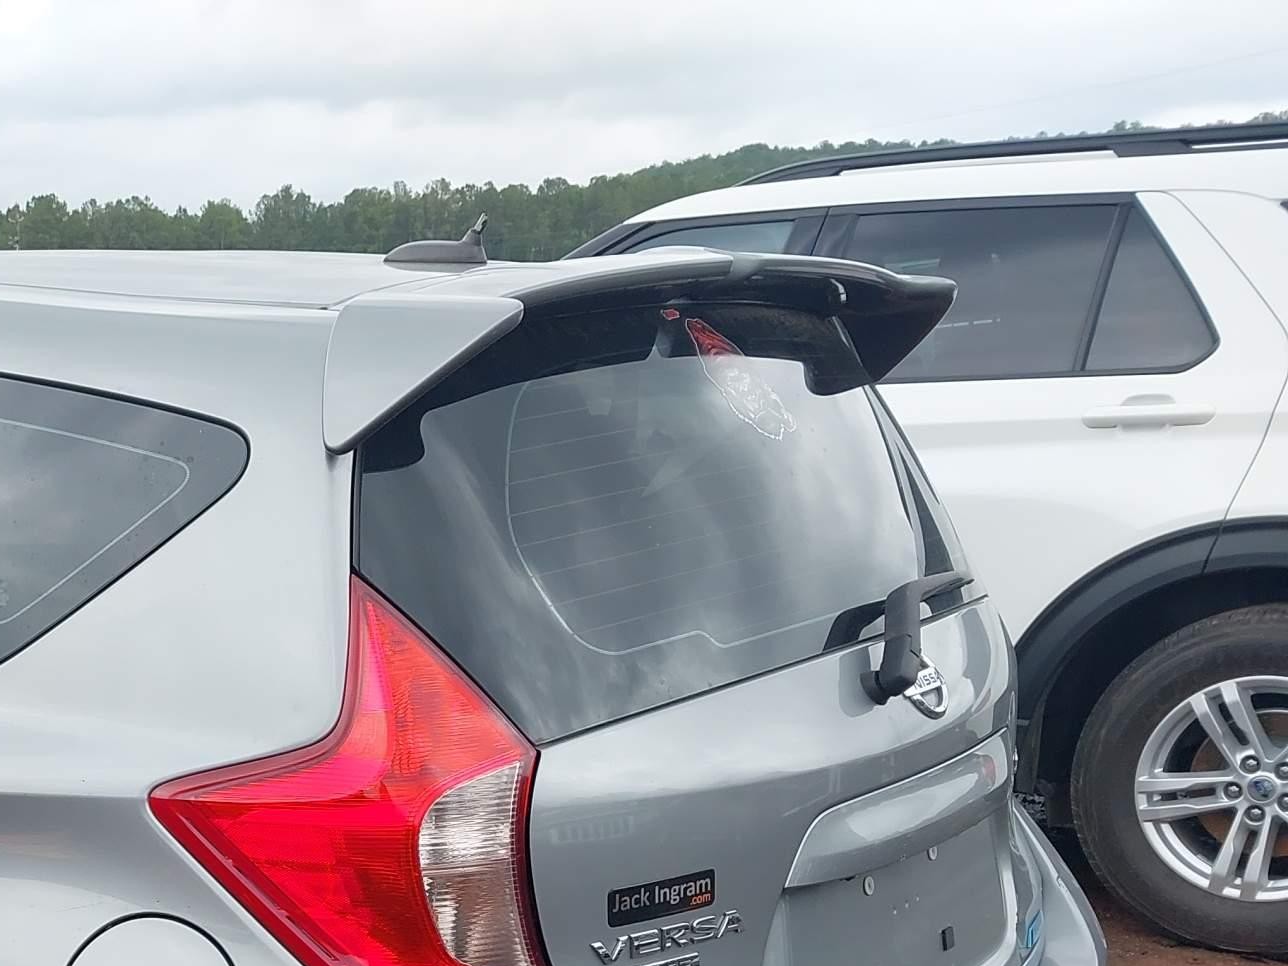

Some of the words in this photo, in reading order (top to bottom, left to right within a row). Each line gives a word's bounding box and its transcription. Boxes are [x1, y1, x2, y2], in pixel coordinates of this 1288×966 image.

[612, 887, 651, 913] Jack
[654, 876, 711, 905] Ingram
[689, 892, 711, 906] .com
[590, 909, 744, 964] VERSA
